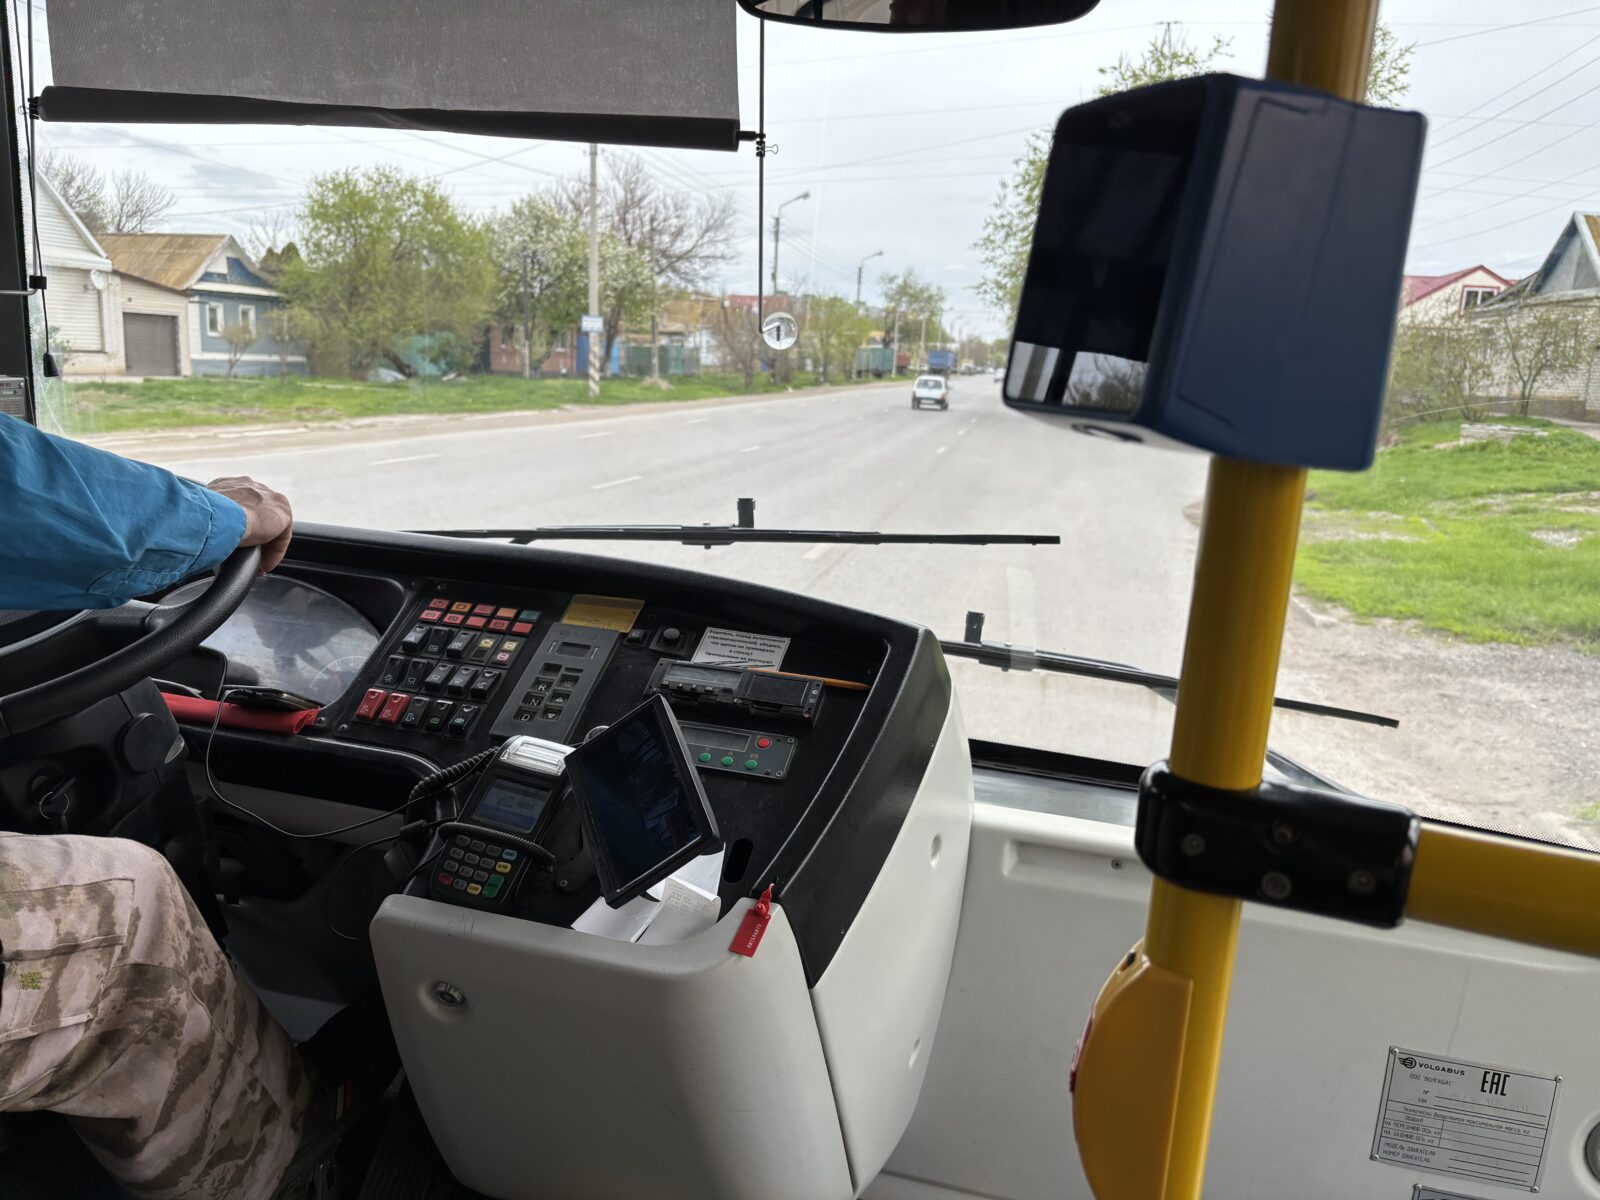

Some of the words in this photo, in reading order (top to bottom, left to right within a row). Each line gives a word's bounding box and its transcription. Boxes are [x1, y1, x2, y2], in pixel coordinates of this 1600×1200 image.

[530, 699, 539, 707] N
[521, 713, 530, 722] D
[1418, 1062, 1465, 1076] VOLGABUS
[1481, 1071, 1510, 1096] EAC
[1384, 1142, 1405, 1150] МОДЕЛЬ
[1406, 1146, 1435, 1156] ДВИГАТЕЛЯ
[1400, 1153, 1430, 1163] ДВИГАТЕЛЯ
